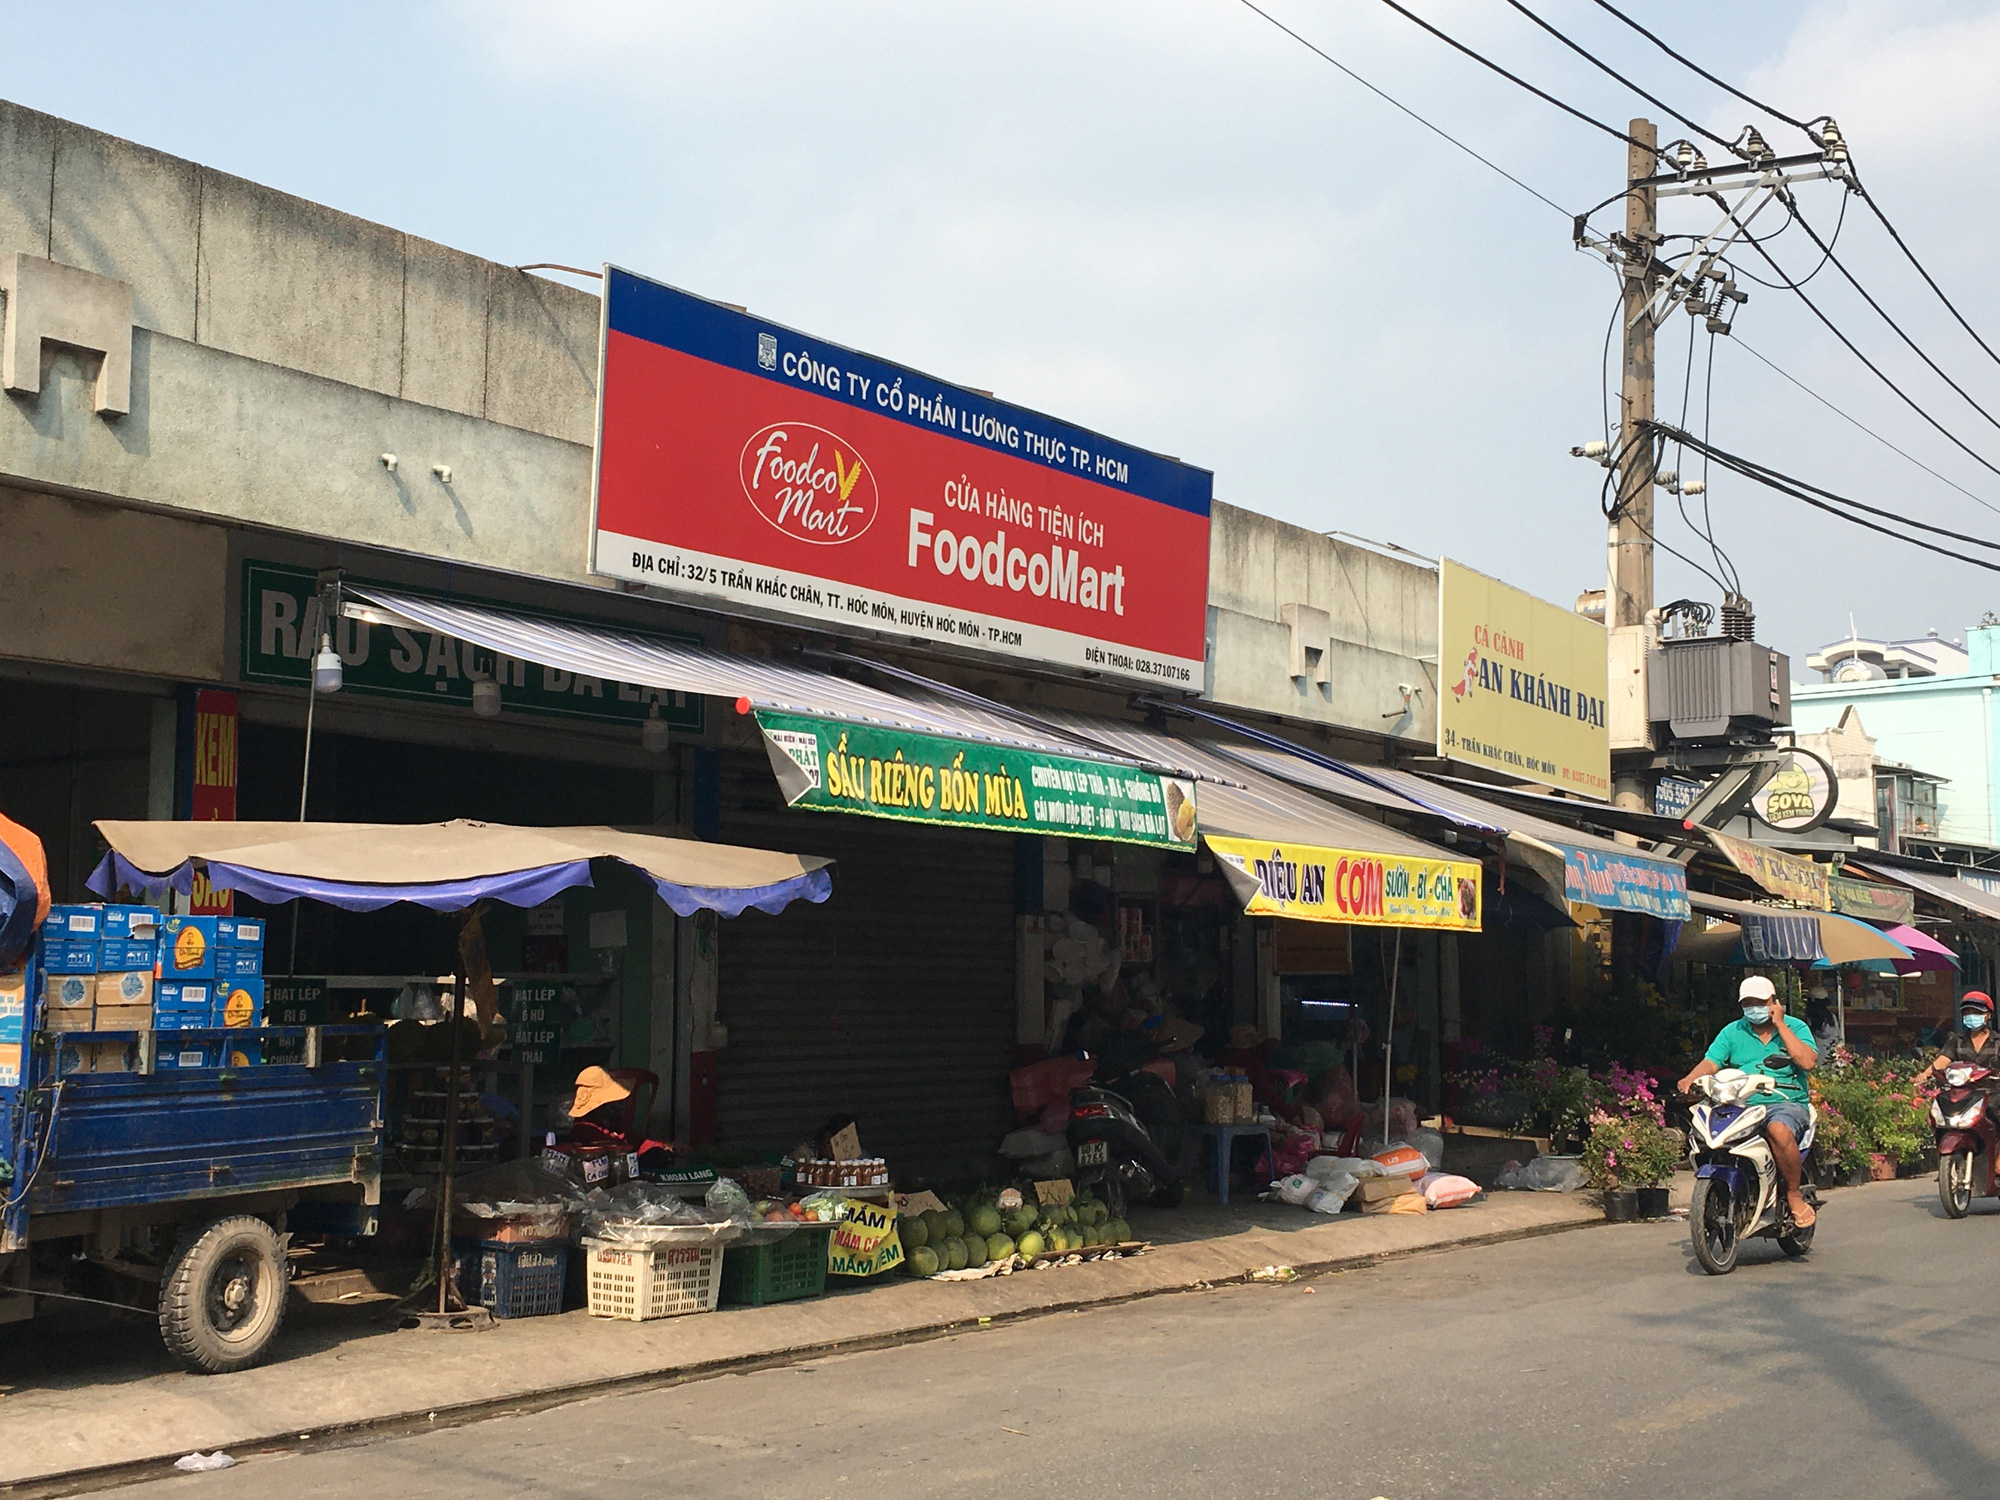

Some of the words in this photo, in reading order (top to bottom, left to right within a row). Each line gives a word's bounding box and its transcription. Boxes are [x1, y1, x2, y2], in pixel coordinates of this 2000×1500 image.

[783, 351, 840, 391] CÔNG
[847, 372, 871, 400] TY
[876, 377, 903, 411] CỔ
[908, 393, 956, 429] PHẦN
[962, 411, 1019, 448] LƯƠNG
[1024, 431, 1066, 463] THỰC
[1071, 446, 1091, 472] TP.
[1096, 455, 1128, 484] HCM
[753, 430, 837, 494] Foodco
[775, 487, 864, 537] Mart
[944, 474, 981, 514] CỬA
[986, 488, 1032, 528] HÀNG
[1038, 505, 1073, 541] TIỆN
[1078, 512, 1104, 548] ÍCH
[908, 508, 1125, 616] FoodcoMart
[632, 552, 653, 573] ĐỊA
[721, 568, 751, 591] TRẦN
[756, 576, 787, 598] KHẮC
[827, 593, 843, 609] TT.
[872, 601, 897, 624] MÔN,
[901, 610, 933, 630] HUYỆN
[959, 620, 979, 638] MÔN
[988, 627, 1021, 646] TP.HCM
[1085, 646, 1105, 665] ĐIỆN
[1108, 653, 1133, 671] THOẠI:
[1136, 659, 1190, 681] 028.37107166
[1474, 624, 1490, 648] CÁ
[1493, 630, 1524, 661] CẢNH
[1478, 657, 1503, 694] AN
[1510, 668, 1571, 717] KHÁNH
[1577, 692, 1605, 730] ĐẠI
[195, 711, 235, 788] KEM
[1445, 728, 1455, 747] 34
[826, 730, 865, 801] SẦU
[870, 748, 935, 810] RIÊNG
[939, 750, 979, 813] BỐN
[984, 765, 1028, 820] MÙA
[1768, 792, 1813, 813] SOYA
[1300, 863, 1325, 905] AN
[1334, 856, 1384, 917] CƠM
[1385, 864, 1410, 898] SƯỜN
[1417, 867, 1427, 899] BÌ
[1434, 865, 1454, 901] CHẢ
[534, 986, 556, 1001] LÉP
[534, 1028, 555, 1043] LÉP
[660, 1172, 688, 1182] KHOAI
[688, 1169, 713, 1180] LANG
[834, 1227, 861, 1250] MẮM
[832, 1253, 873, 1274] MẮM
